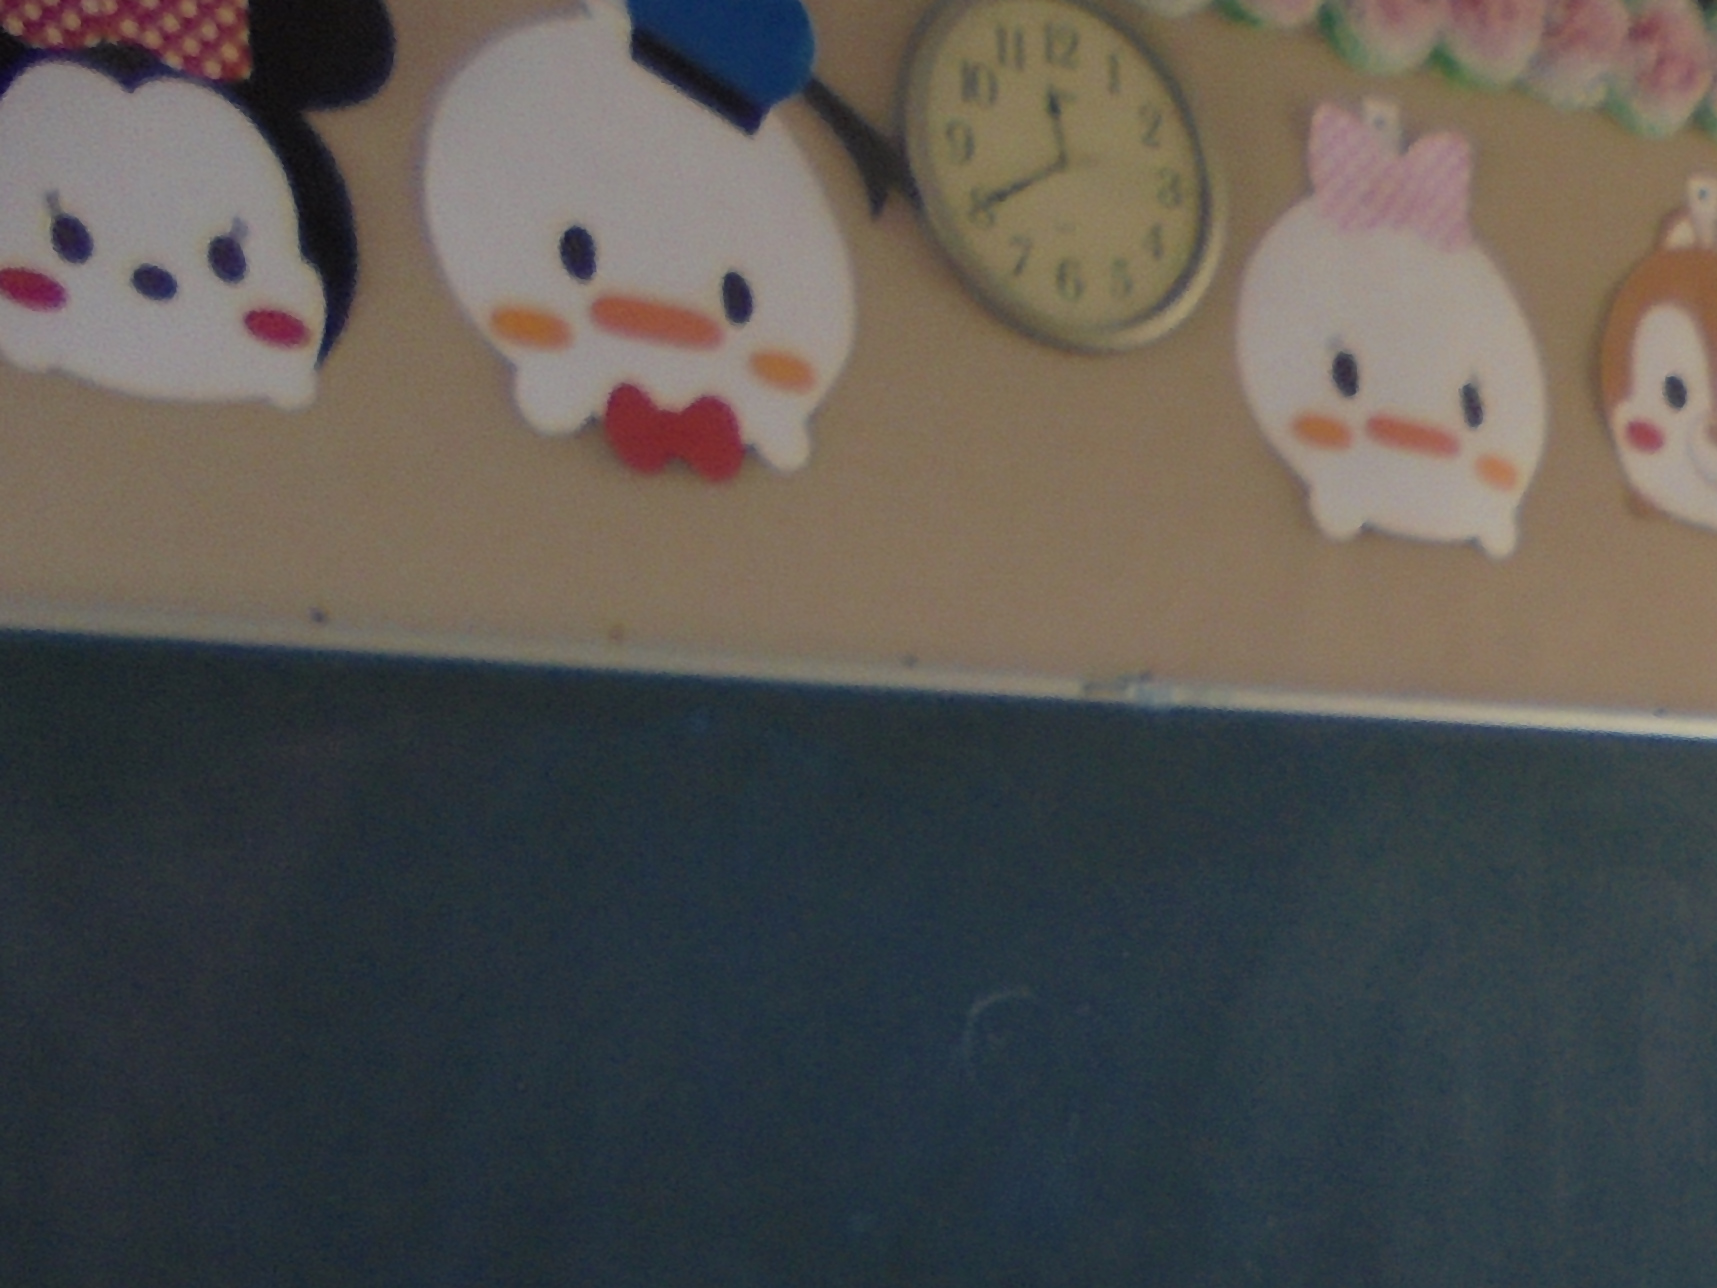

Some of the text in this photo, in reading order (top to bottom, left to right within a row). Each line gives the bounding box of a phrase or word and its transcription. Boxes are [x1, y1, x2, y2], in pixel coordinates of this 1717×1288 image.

[996, 26, 1025, 70] 11
[1044, 22, 1079, 69] 12
[961, 61, 999, 105] 10
[1107, 53, 1122, 95] 1
[945, 118, 976, 163] 9
[1138, 102, 1163, 147] 2
[1157, 168, 1184, 208] 3
[1009, 235, 1033, 276] 7
[1142, 223, 1165, 260] 4
[1055, 258, 1085, 302] 6
